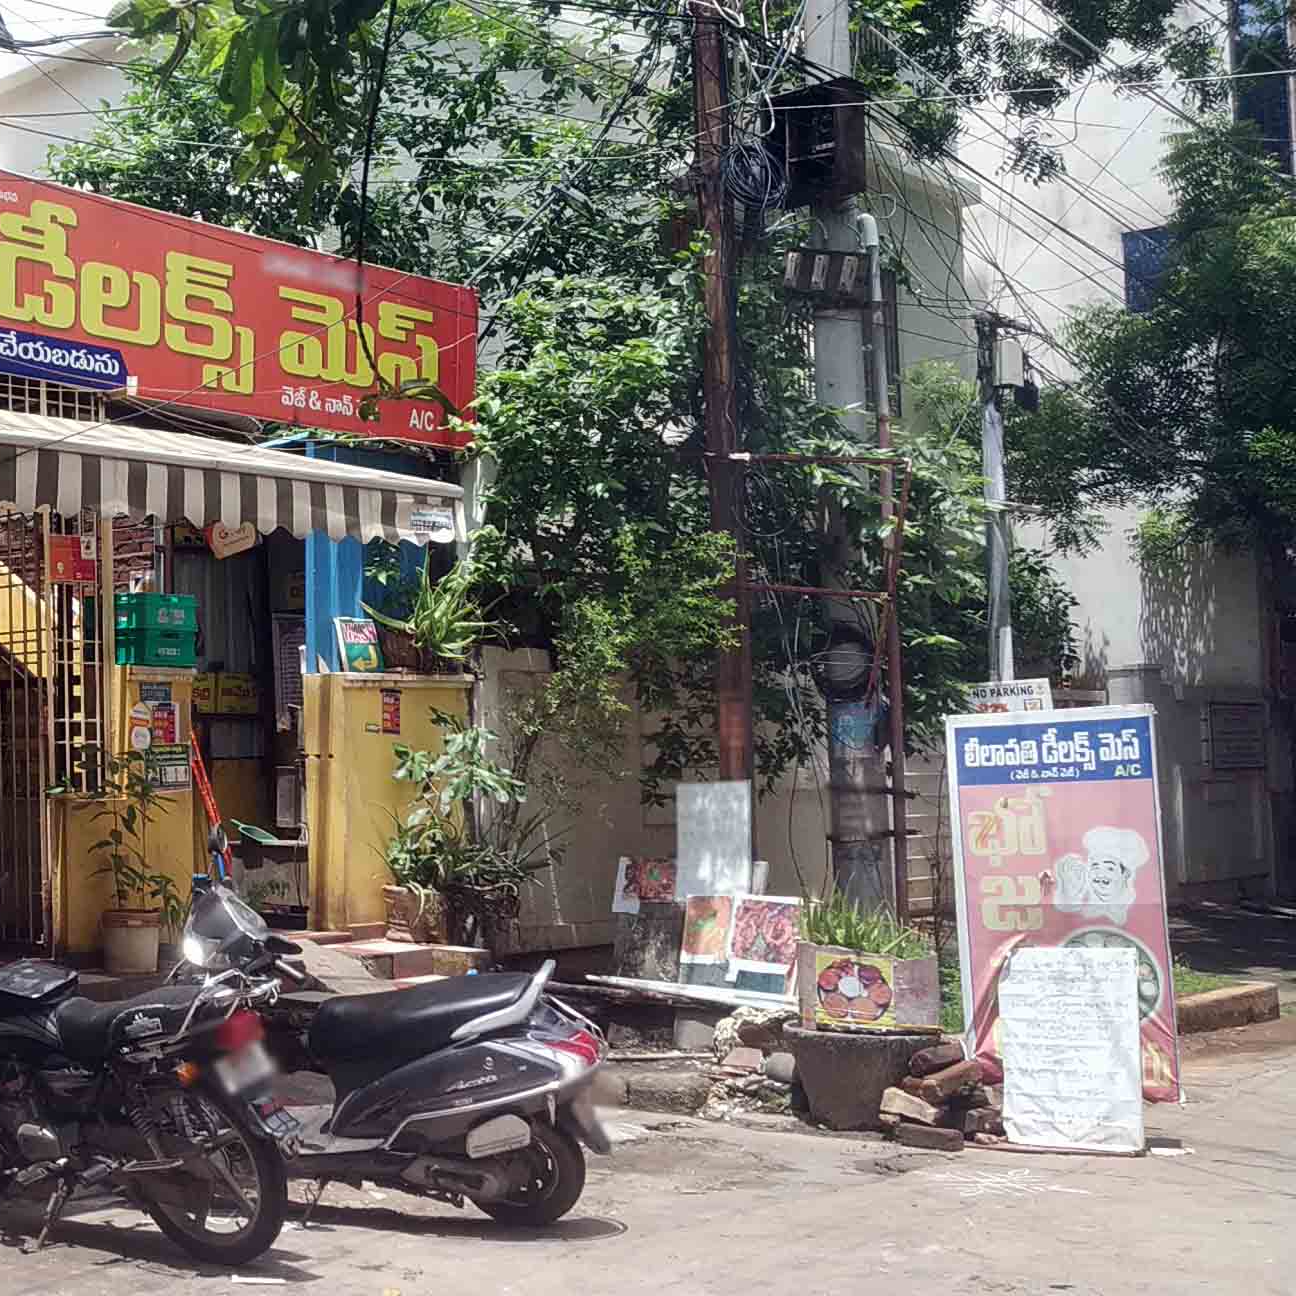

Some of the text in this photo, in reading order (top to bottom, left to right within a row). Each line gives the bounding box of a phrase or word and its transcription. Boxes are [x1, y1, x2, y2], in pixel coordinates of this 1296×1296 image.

[279, 286, 439, 388] మెస్
[309, 390, 321, 410] &
[409, 408, 435, 431] A/C
[990, 684, 1034, 698] PARKING
[964, 728, 1140, 770] లీలావతి డీలక్స్ మెస్
[1114, 763, 1142, 777] A/C
